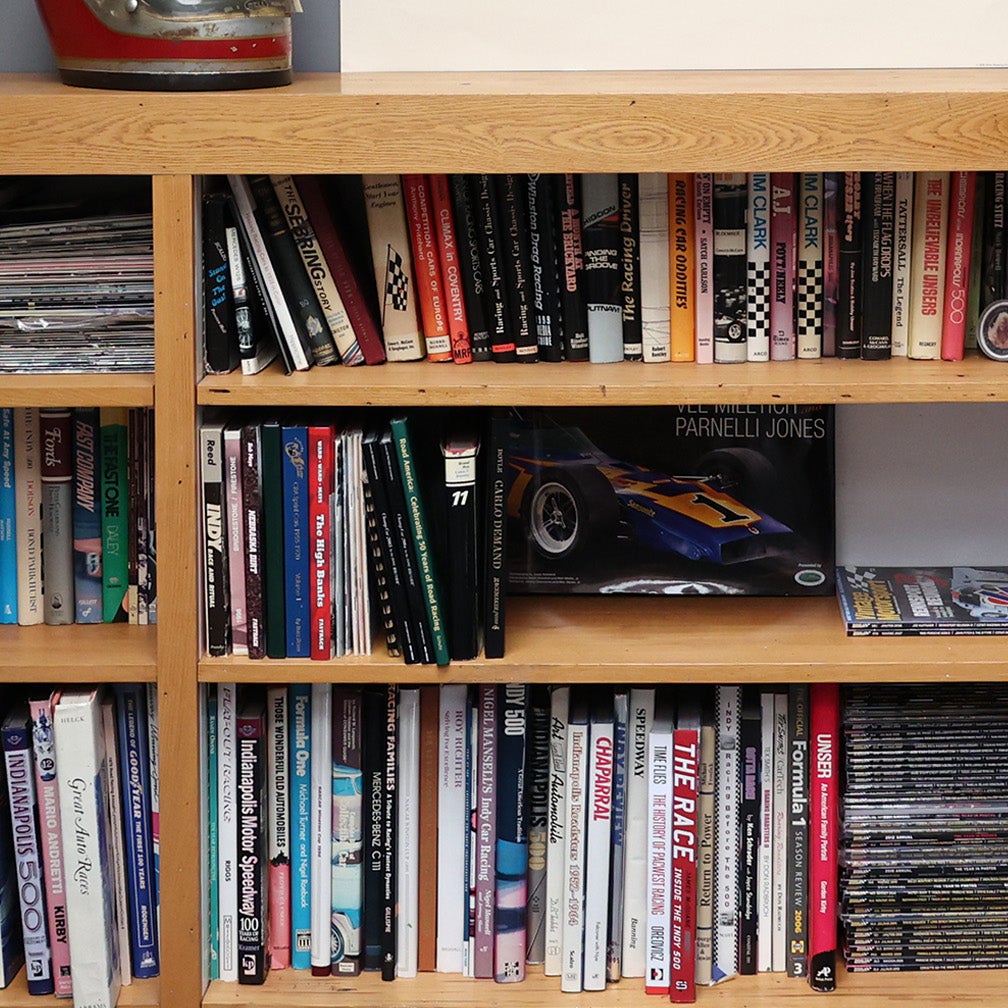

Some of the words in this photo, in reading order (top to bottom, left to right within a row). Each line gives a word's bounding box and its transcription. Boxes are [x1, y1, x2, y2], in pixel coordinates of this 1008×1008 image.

[417, 184, 432, 248] COMPETITION
[528, 182, 538, 230] Winston
[620, 183, 632, 233] Driver
[675, 180, 686, 225] RACING
[772, 186, 791, 217] A.J.
[881, 203, 892, 219] THE
[439, 209, 454, 249] CLIMAX
[676, 229, 686, 252] CAR
[753, 195, 767, 250] CLARK
[881, 221, 892, 245] FLAG
[897, 199, 908, 271] TATTERSALL
[924, 200, 942, 272] UNBELIEVABLE
[415, 223, 426, 261] Pritchard
[446, 252, 454, 262] in
[530, 232, 540, 263] Drag
[700, 238, 708, 260] SATCH
[952, 233, 964, 288] INDIANAPOLIS
[426, 251, 436, 277] CARS
[563, 233, 577, 292] BRICKYARD
[622, 240, 636, 292] Racing
[700, 262, 709, 294] CARLSON
[880, 246, 891, 278] DROPS
[314, 279, 332, 311] STORY
[430, 280, 438, 292] OF
[447, 266, 463, 322] COVENTRY
[533, 265, 544, 311] Racing
[676, 256, 687, 309] ODDITIES
[896, 277, 904, 294] The
[922, 274, 938, 316] UNSERS
[432, 295, 443, 332] EUROPE
[623, 297, 635, 322] The
[895, 296, 904, 327] Legend
[950, 290, 964, 324] 500
[76, 421, 94, 452] FAST
[676, 417, 760, 438] PARNELLI
[766, 418, 826, 438] JONES
[46, 427, 62, 468] Fords
[207, 440, 215, 466] Reed
[399, 438, 408, 458] Road
[76, 450, 94, 512] COMPANY
[452, 490, 468, 507] 11
[494, 480, 504, 518] CARLO
[316, 514, 324, 536] The
[410, 496, 424, 540] Celebrating
[690, 493, 750, 524] 1
[106, 525, 119, 556] DALEY
[206, 503, 222, 552] INDY
[248, 510, 257, 553] NEBRASKA
[418, 541, 427, 551] 50
[493, 520, 503, 569] DEMAND
[249, 554, 258, 574] DIRT
[315, 538, 325, 567] High
[421, 552, 430, 572] Years
[316, 570, 324, 607] Banks
[426, 584, 436, 604] Road
[430, 606, 442, 632] Racing
[275, 697, 285, 724] THOSE
[295, 695, 310, 748] Formula
[482, 688, 494, 725] NIGEL
[552, 717, 564, 740] Art
[634, 708, 646, 779] SPEEDWAY
[275, 726, 285, 774] WONDERFUL
[296, 750, 309, 777] One
[386, 736, 396, 791] FAMILIES
[570, 732, 583, 802] Indianapolis
[654, 746, 666, 764] TIME
[674, 744, 696, 790] THE
[817, 734, 832, 778] UNSER
[130, 750, 144, 818] GOODYEAR
[223, 763, 232, 823] RACING
[238, 739, 257, 815] Indianapolis
[276, 776, 285, 790] OLD
[594, 736, 614, 821] CHAPARRAL
[654, 765, 666, 785] FLIES
[792, 740, 806, 813] Formula
[8, 753, 34, 855] INDIANAPOLIS
[42, 786, 59, 828] MARIO
[68, 778, 87, 814] Great
[372, 772, 381, 846] MERCEDES-BENZ
[480, 797, 492, 821] Indy
[550, 774, 564, 844] Automobile
[75, 817, 91, 854] Auto
[241, 816, 257, 854] Motor
[275, 792, 286, 848] AUTOMOBILES
[481, 823, 491, 842] Car
[570, 805, 581, 861] Roadsters
[674, 796, 694, 862] RACE
[700, 814, 712, 848] Power
[792, 818, 806, 826] 1
[46, 831, 63, 894] ANDRETTI
[372, 850, 381, 858] C
[478, 845, 491, 881] Racing
[700, 852, 711, 865] to
[794, 832, 802, 868] SEASON
[74, 856, 92, 896] Races
[224, 860, 232, 882] RIGGS
[239, 855, 258, 916] Speedway
[700, 868, 712, 906] Return
[794, 872, 802, 906] REVIEW
[19, 861, 42, 932] 500
[54, 906, 67, 944] KIRBY
[240, 918, 258, 932] 100
[630, 918, 638, 949] Banning
[794, 910, 802, 934] 2006
[650, 926, 664, 961] OREOVICZ
